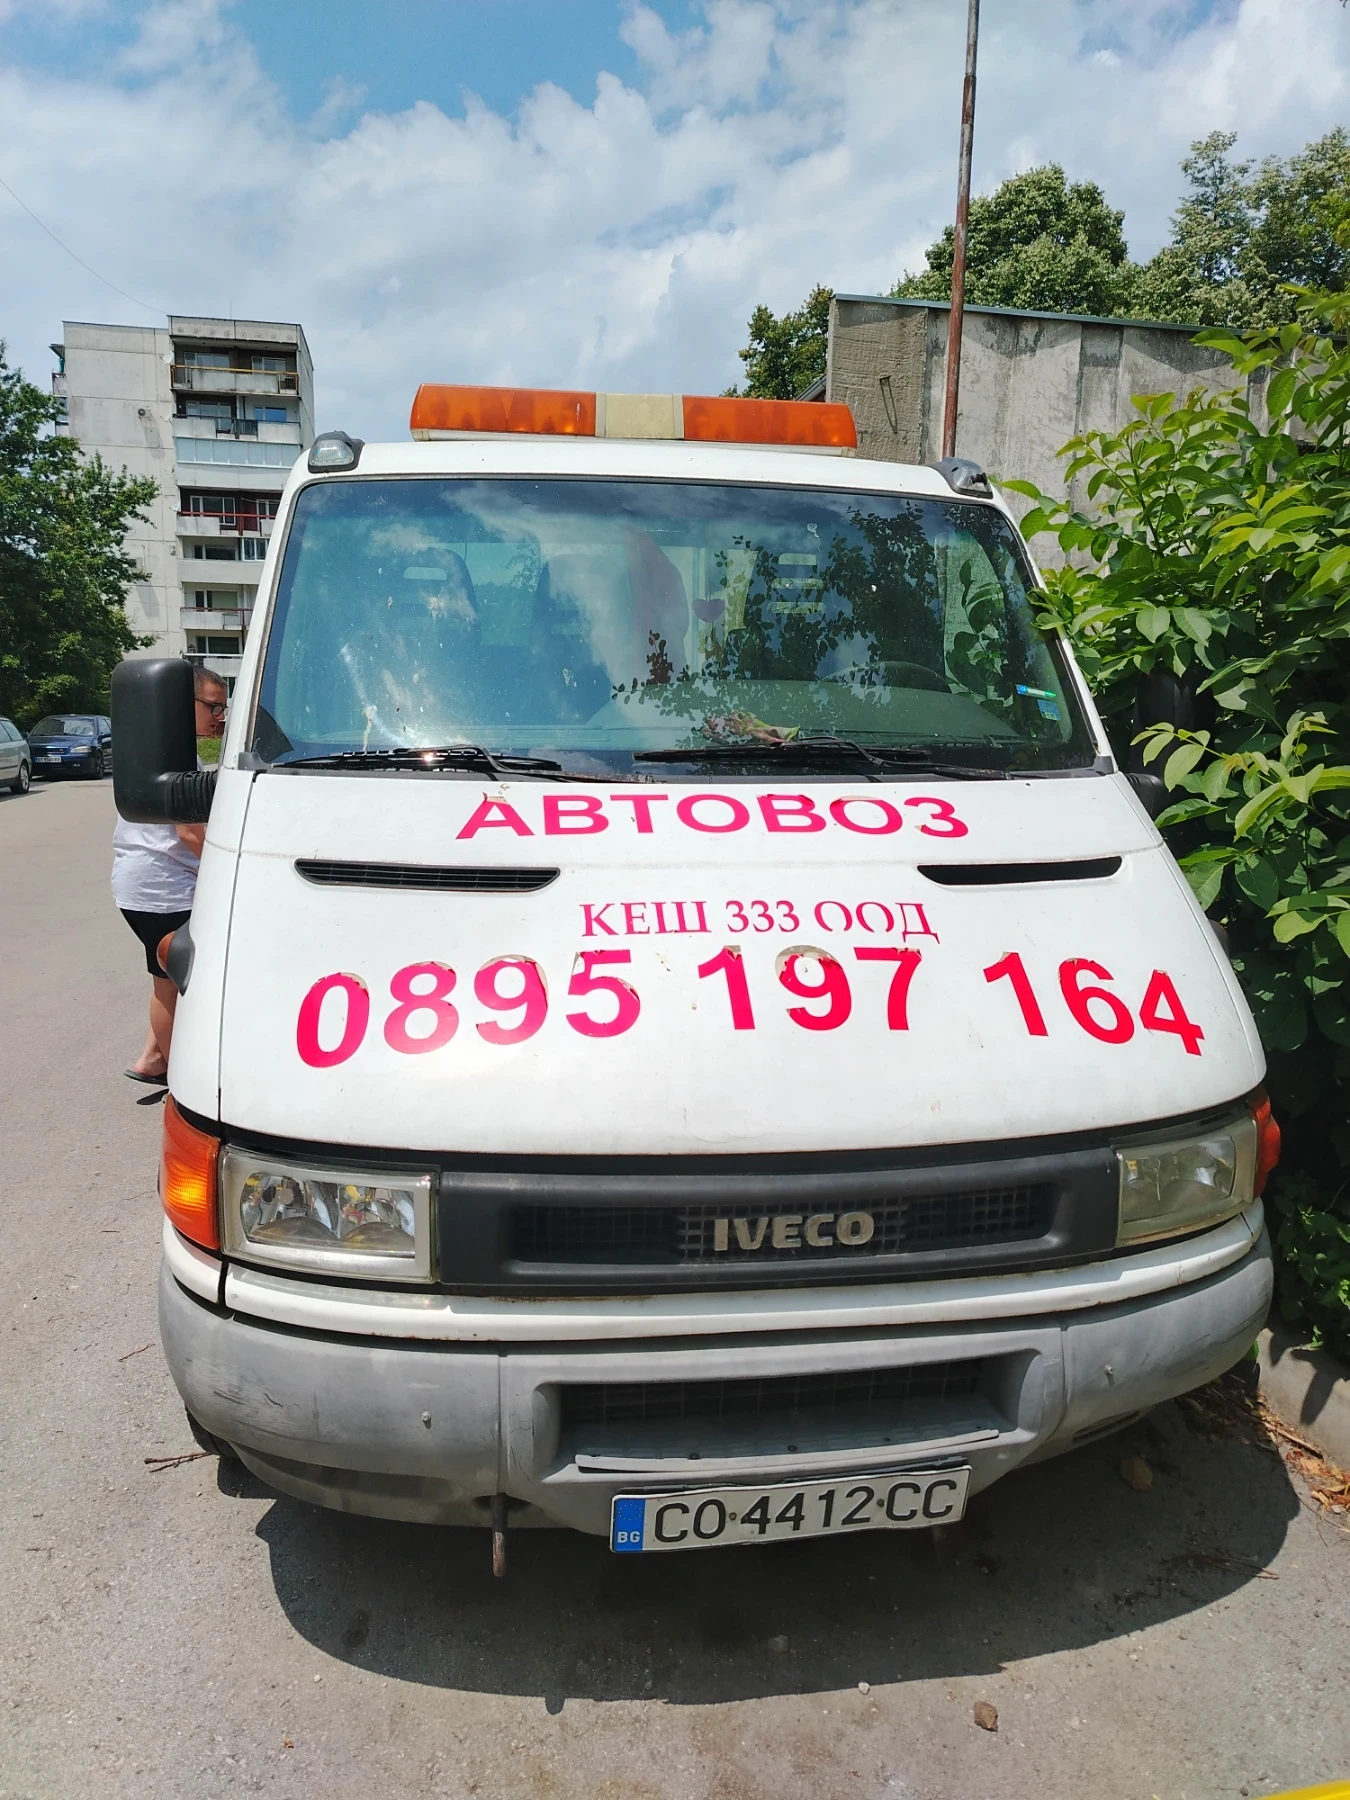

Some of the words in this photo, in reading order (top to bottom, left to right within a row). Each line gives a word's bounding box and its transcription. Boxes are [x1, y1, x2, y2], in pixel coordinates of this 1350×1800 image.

[457, 792, 969, 840] АВТОВОЗ
[582, 900, 709, 937] КЕШ
[725, 899, 802, 933] 333
[814, 901, 940, 943] ООД
[296, 948, 641, 1068] 0895
[698, 946, 923, 1032] 197
[983, 951, 1205, 1057] 164
[713, 1211, 876, 1252] IVECO
[616, 1530, 641, 1544] BG
